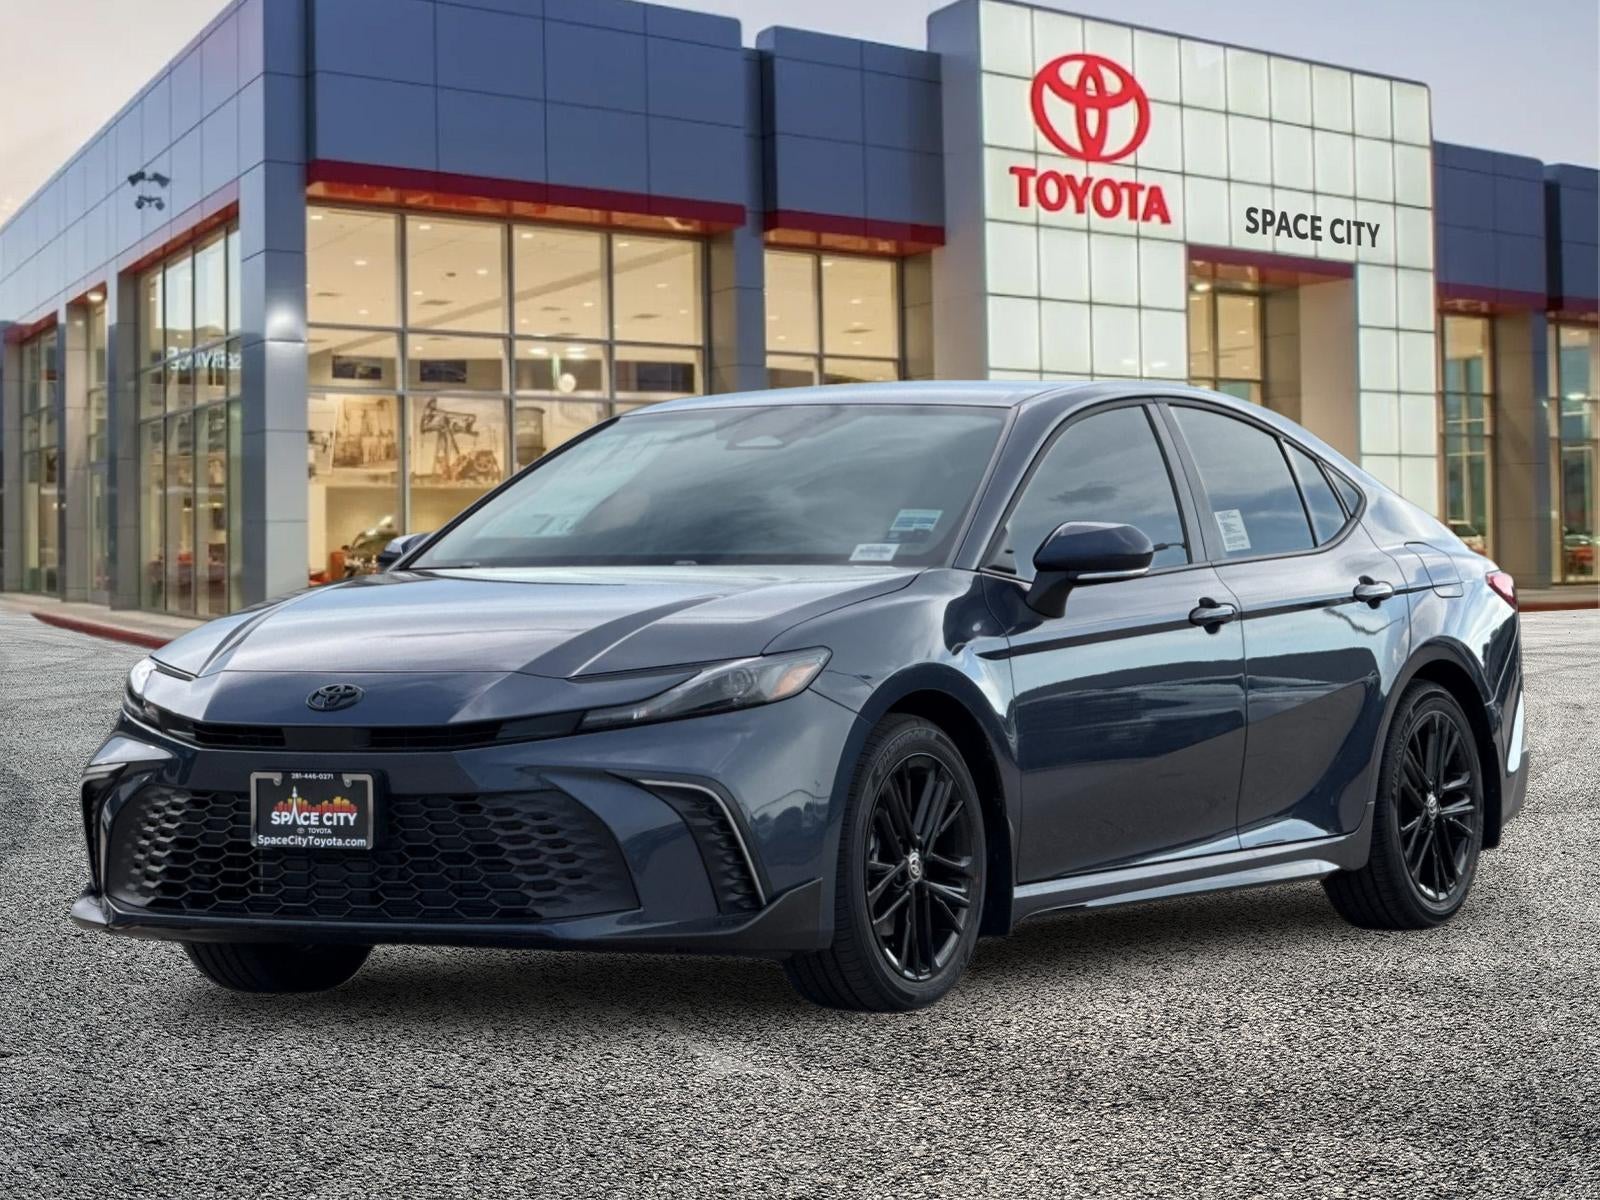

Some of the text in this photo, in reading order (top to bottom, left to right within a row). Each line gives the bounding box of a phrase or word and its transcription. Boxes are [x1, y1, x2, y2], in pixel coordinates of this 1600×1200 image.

[1009, 166, 1171, 225] TOYOTA
[1245, 206, 1381, 248] SPACE CITY
[291, 772, 334, 780] 281-446-0271
[270, 812, 357, 825] SPACE CITY
[257, 835, 367, 847] SpaceCityToyota.com
